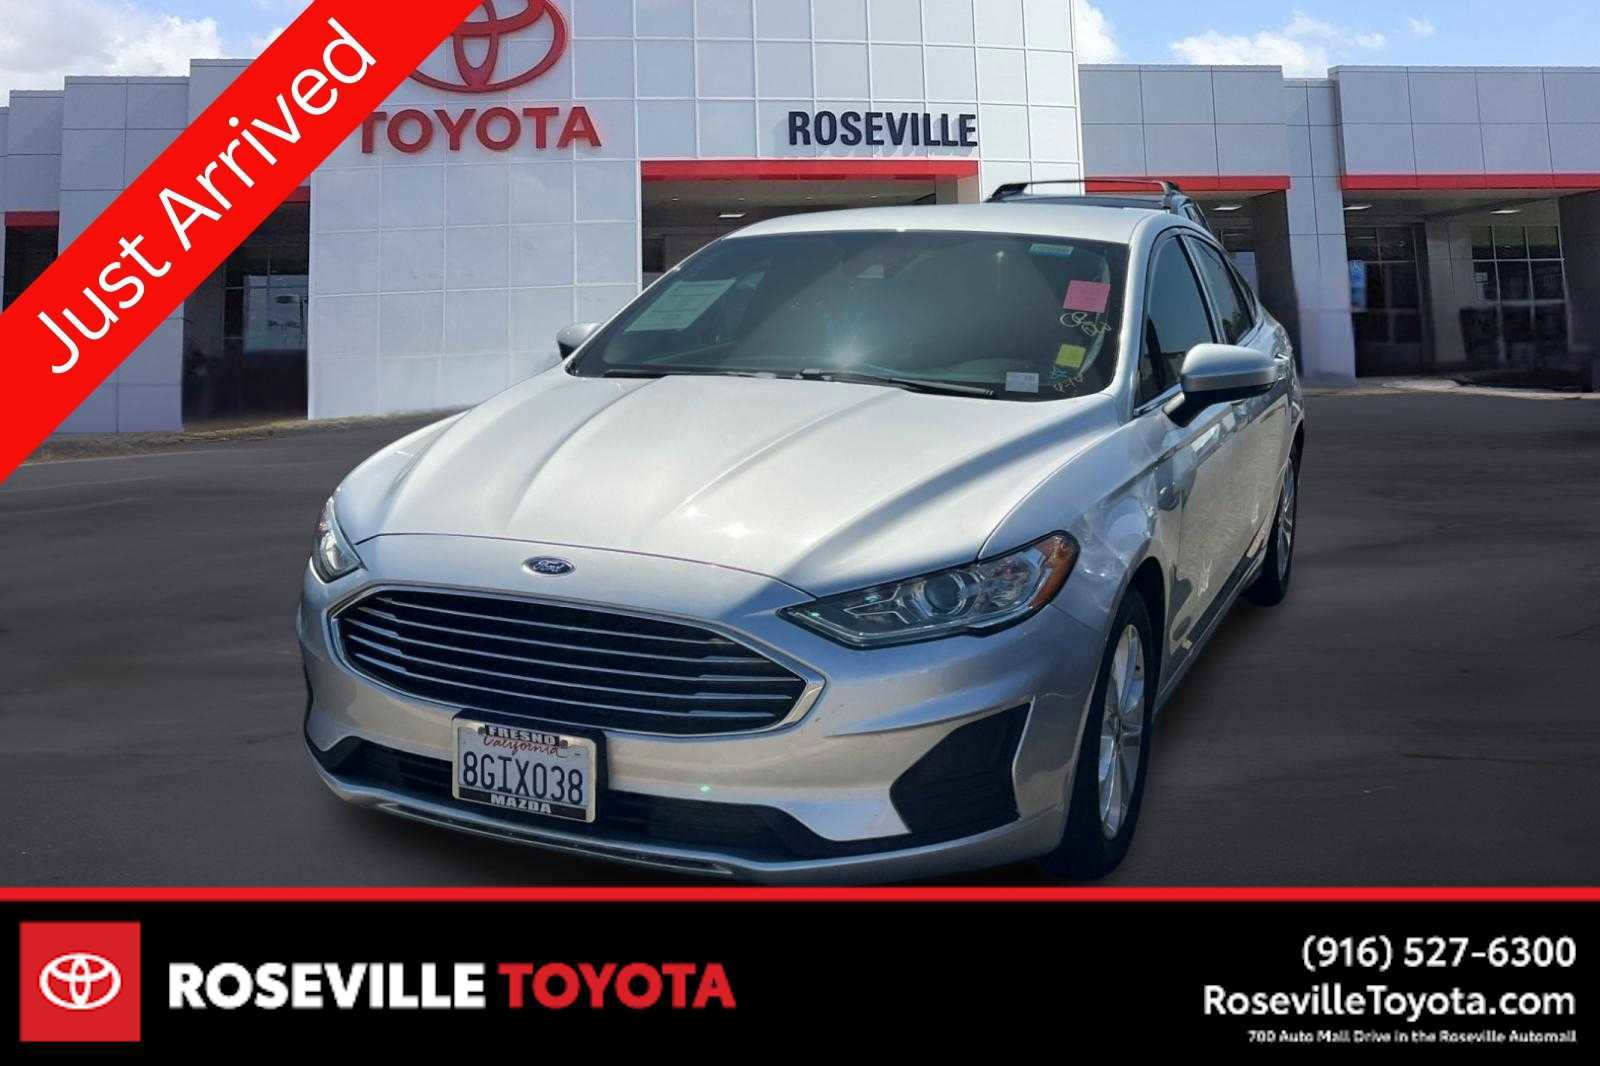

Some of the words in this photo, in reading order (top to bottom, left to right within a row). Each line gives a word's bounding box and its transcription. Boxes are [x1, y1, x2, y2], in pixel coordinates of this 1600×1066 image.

[361, 106, 602, 153] TOYOTA
[788, 111, 978, 147] ROSEVILLE
[486, 726, 557, 746] FRESNO
[463, 750, 583, 805] 8GIX038
[490, 793, 552, 814] MAZDA
